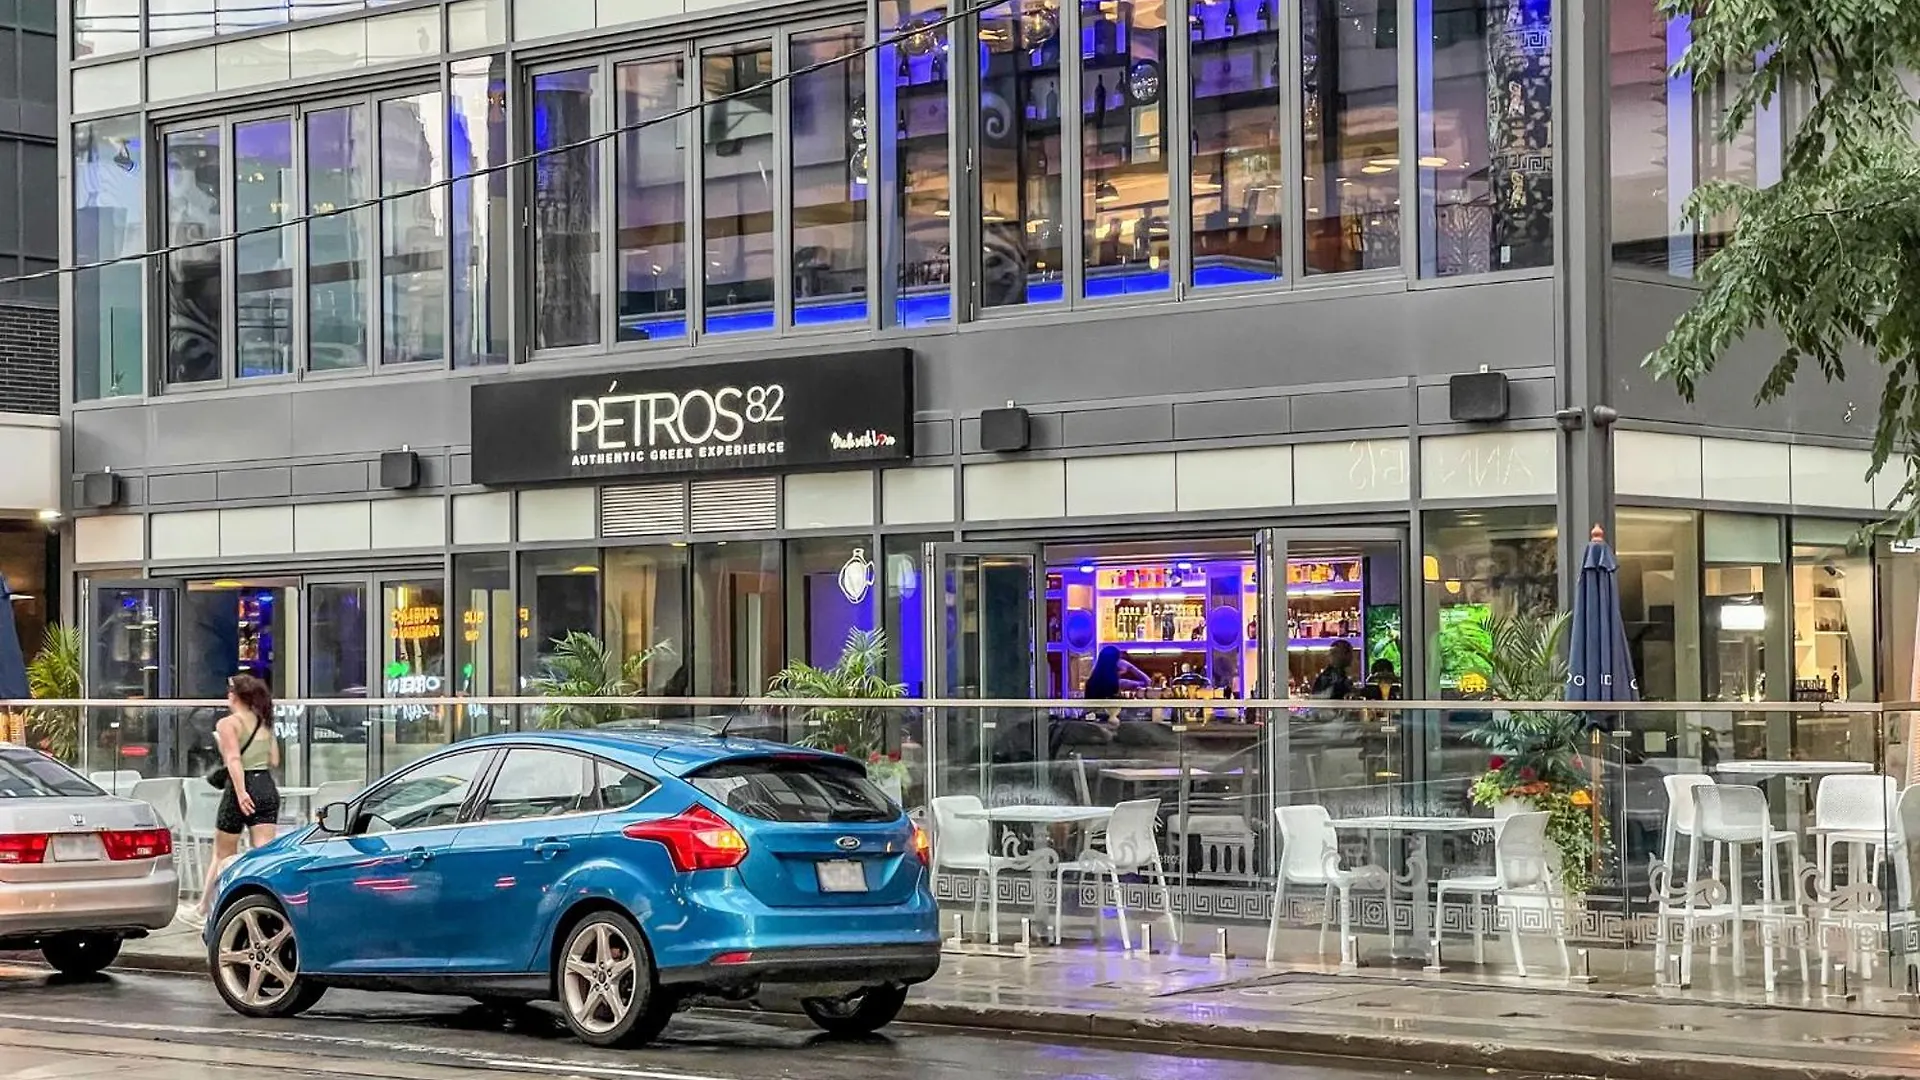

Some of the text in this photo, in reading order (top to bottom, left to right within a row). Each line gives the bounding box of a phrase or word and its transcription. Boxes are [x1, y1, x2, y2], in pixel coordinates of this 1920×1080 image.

[571, 441, 785, 466] AUTHENTIC GREEK EXPERIENCE
